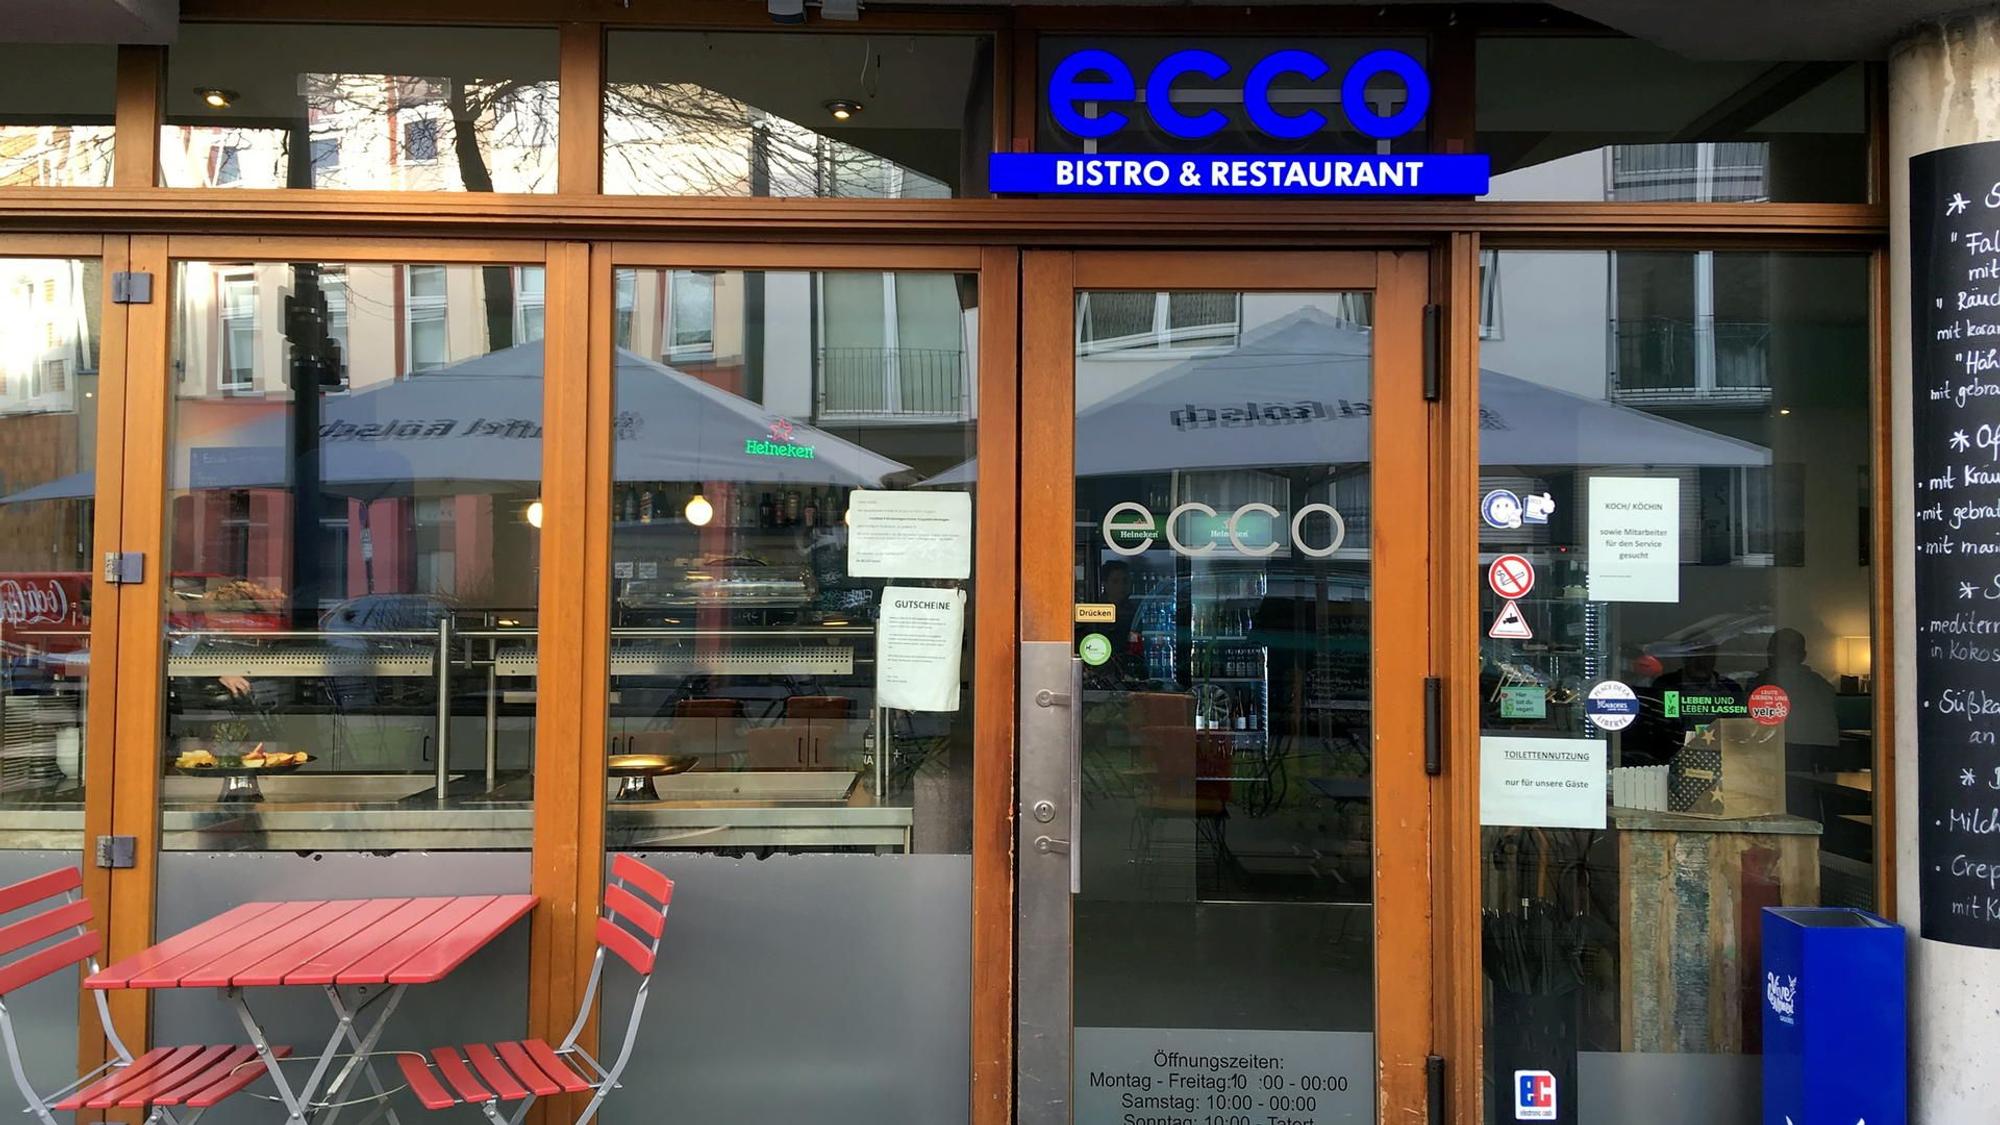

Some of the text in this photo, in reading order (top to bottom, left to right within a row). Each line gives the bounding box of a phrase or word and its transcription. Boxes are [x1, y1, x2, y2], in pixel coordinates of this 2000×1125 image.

[1048, 48, 1431, 139] ecco
[1056, 159, 1424, 188] BISTRO & RESTAURANT
[1968, 258, 2000, 281] mit
[1937, 320, 1961, 340] mit
[1930, 380, 1951, 400] mit
[745, 440, 815, 459] Heineken
[1929, 465, 1957, 491] mit
[1605, 501, 1663, 510] KOCH/ KÖCHIN
[1922, 502, 1943, 521] mit
[1103, 502, 1345, 557] ecco
[1120, 530, 1159, 538] Heineken
[1600, 527, 1667, 536] sowie Mitarbeiter
[1925, 534, 1954, 555] mit
[1619, 552, 1649, 560] gesucht
[895, 599, 951, 611] GUTSCHEINE
[1079, 608, 1112, 617] Drücken
[1930, 640, 1942, 659] in
[1682, 697, 1735, 705] LEBEN UND
[1682, 705, 1748, 714] LEBEN LASSEN
[1753, 707, 1776, 718] yelp
[1968, 730, 1995, 745] an
[1504, 750, 1590, 761] TOILETTENNUTZUNG
[1505, 778, 1589, 789] nur für unsere Gäste
[1952, 896, 1980, 919] mit
[1154, 1052, 1284, 1072] Öffnungszeiten:
[1090, 1072, 1151, 1092] Montag
[1300, 1076, 1348, 1092] 00:00
[1121, 1093, 1200, 1113] Samstag:
[1207, 1095, 1252, 1110] 10:00
[1269, 1096, 1316, 1112] 00:00
